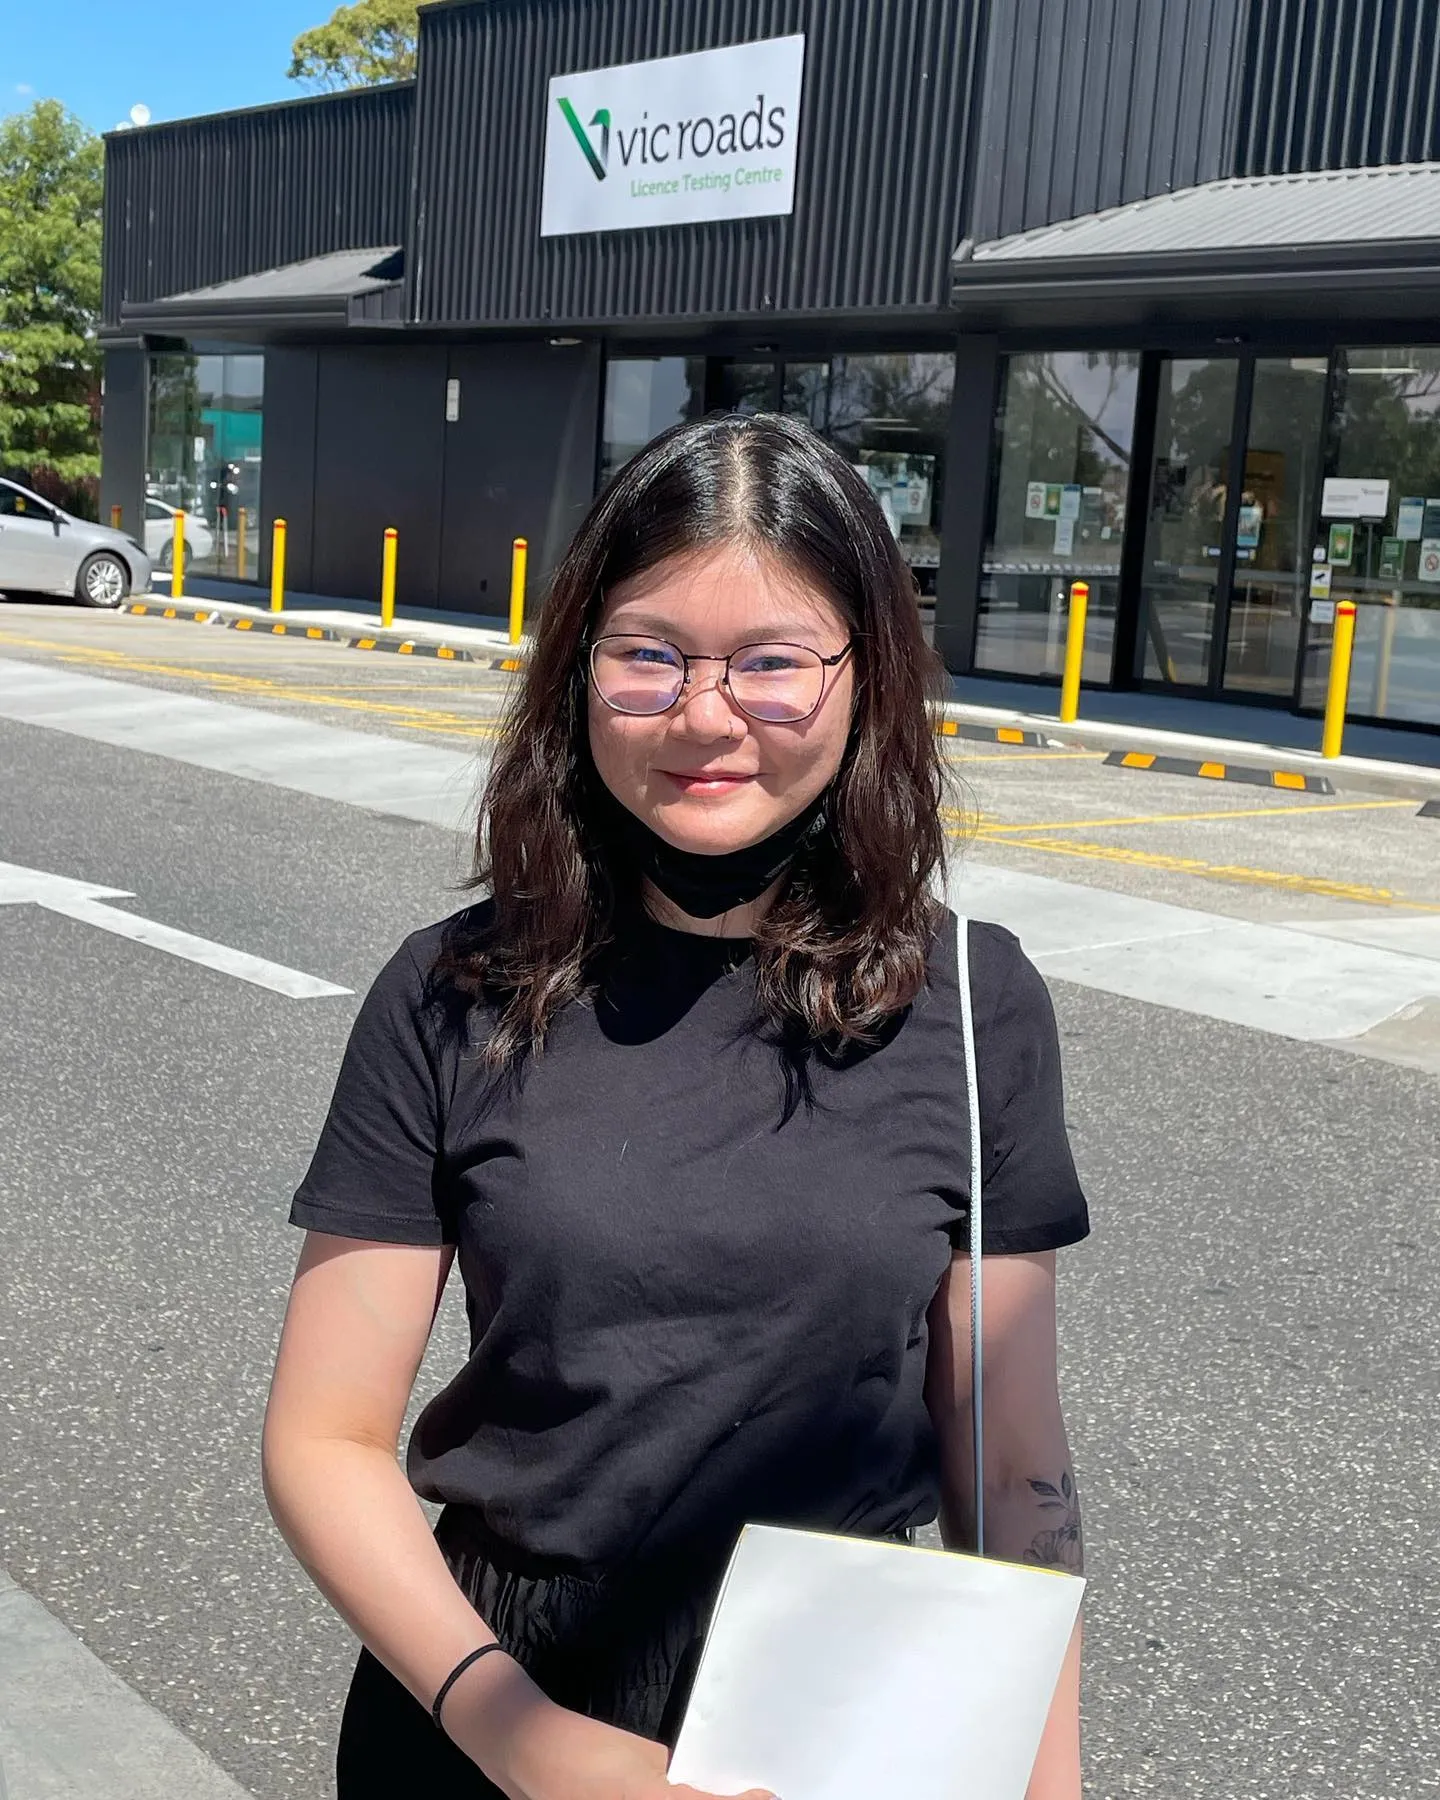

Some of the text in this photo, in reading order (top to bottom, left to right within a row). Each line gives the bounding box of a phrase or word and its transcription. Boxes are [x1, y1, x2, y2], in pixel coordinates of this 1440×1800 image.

[631, 166, 783, 198] Licence Testing Centre
